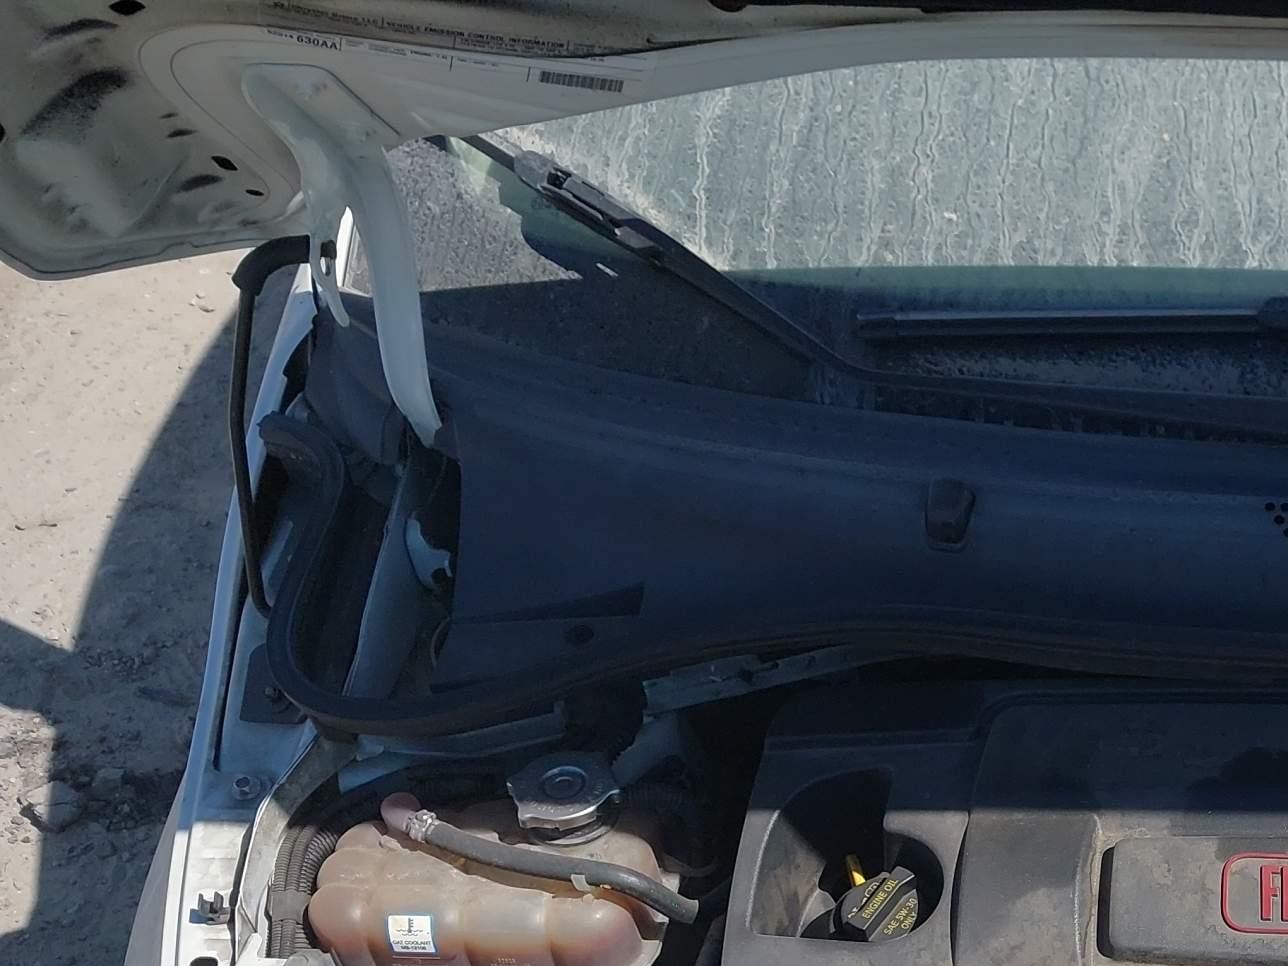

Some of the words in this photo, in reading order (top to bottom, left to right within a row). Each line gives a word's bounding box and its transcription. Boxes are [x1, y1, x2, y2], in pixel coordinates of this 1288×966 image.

[296, 35, 338, 50] 630AA
[862, 891, 888, 919] ENGINE
[884, 879, 898, 892] OIL
[884, 920, 900, 935] SAE
[896, 898, 917, 920] 5W-30
[901, 911, 917, 929] ONLY
